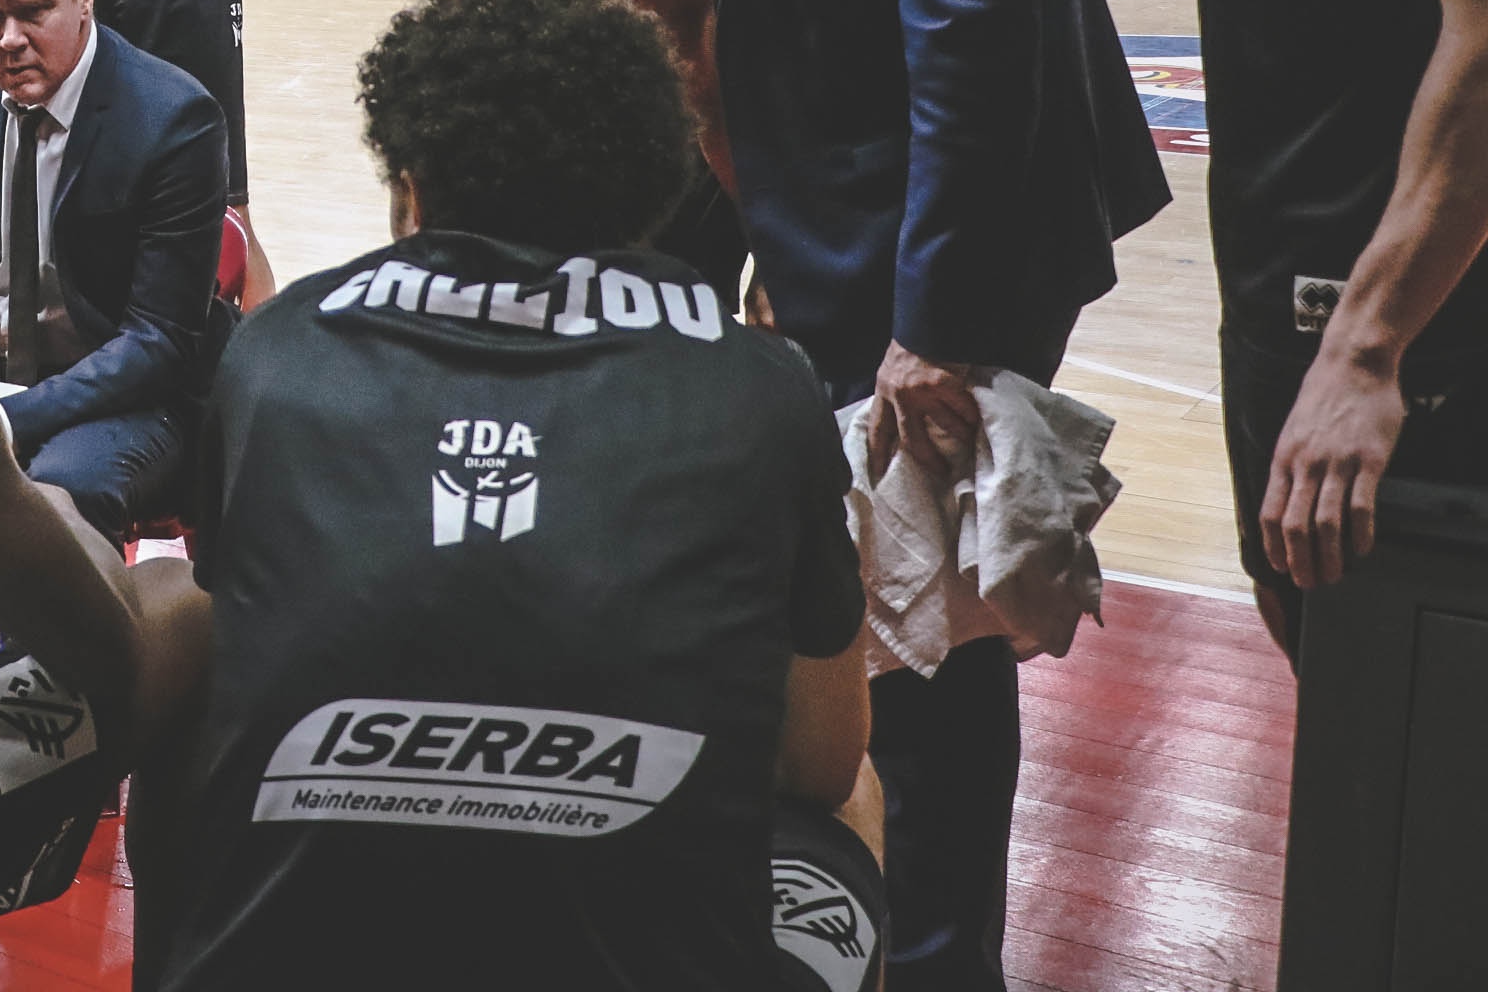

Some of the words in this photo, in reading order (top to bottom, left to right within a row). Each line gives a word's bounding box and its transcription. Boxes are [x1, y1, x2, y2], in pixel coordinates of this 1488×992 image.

[437, 419, 542, 458] JDA
[464, 456, 508, 470] DIJON
[309, 711, 642, 789] ISERBA
[291, 788, 444, 816] Maintenance
[448, 794, 610, 831] immobilière
